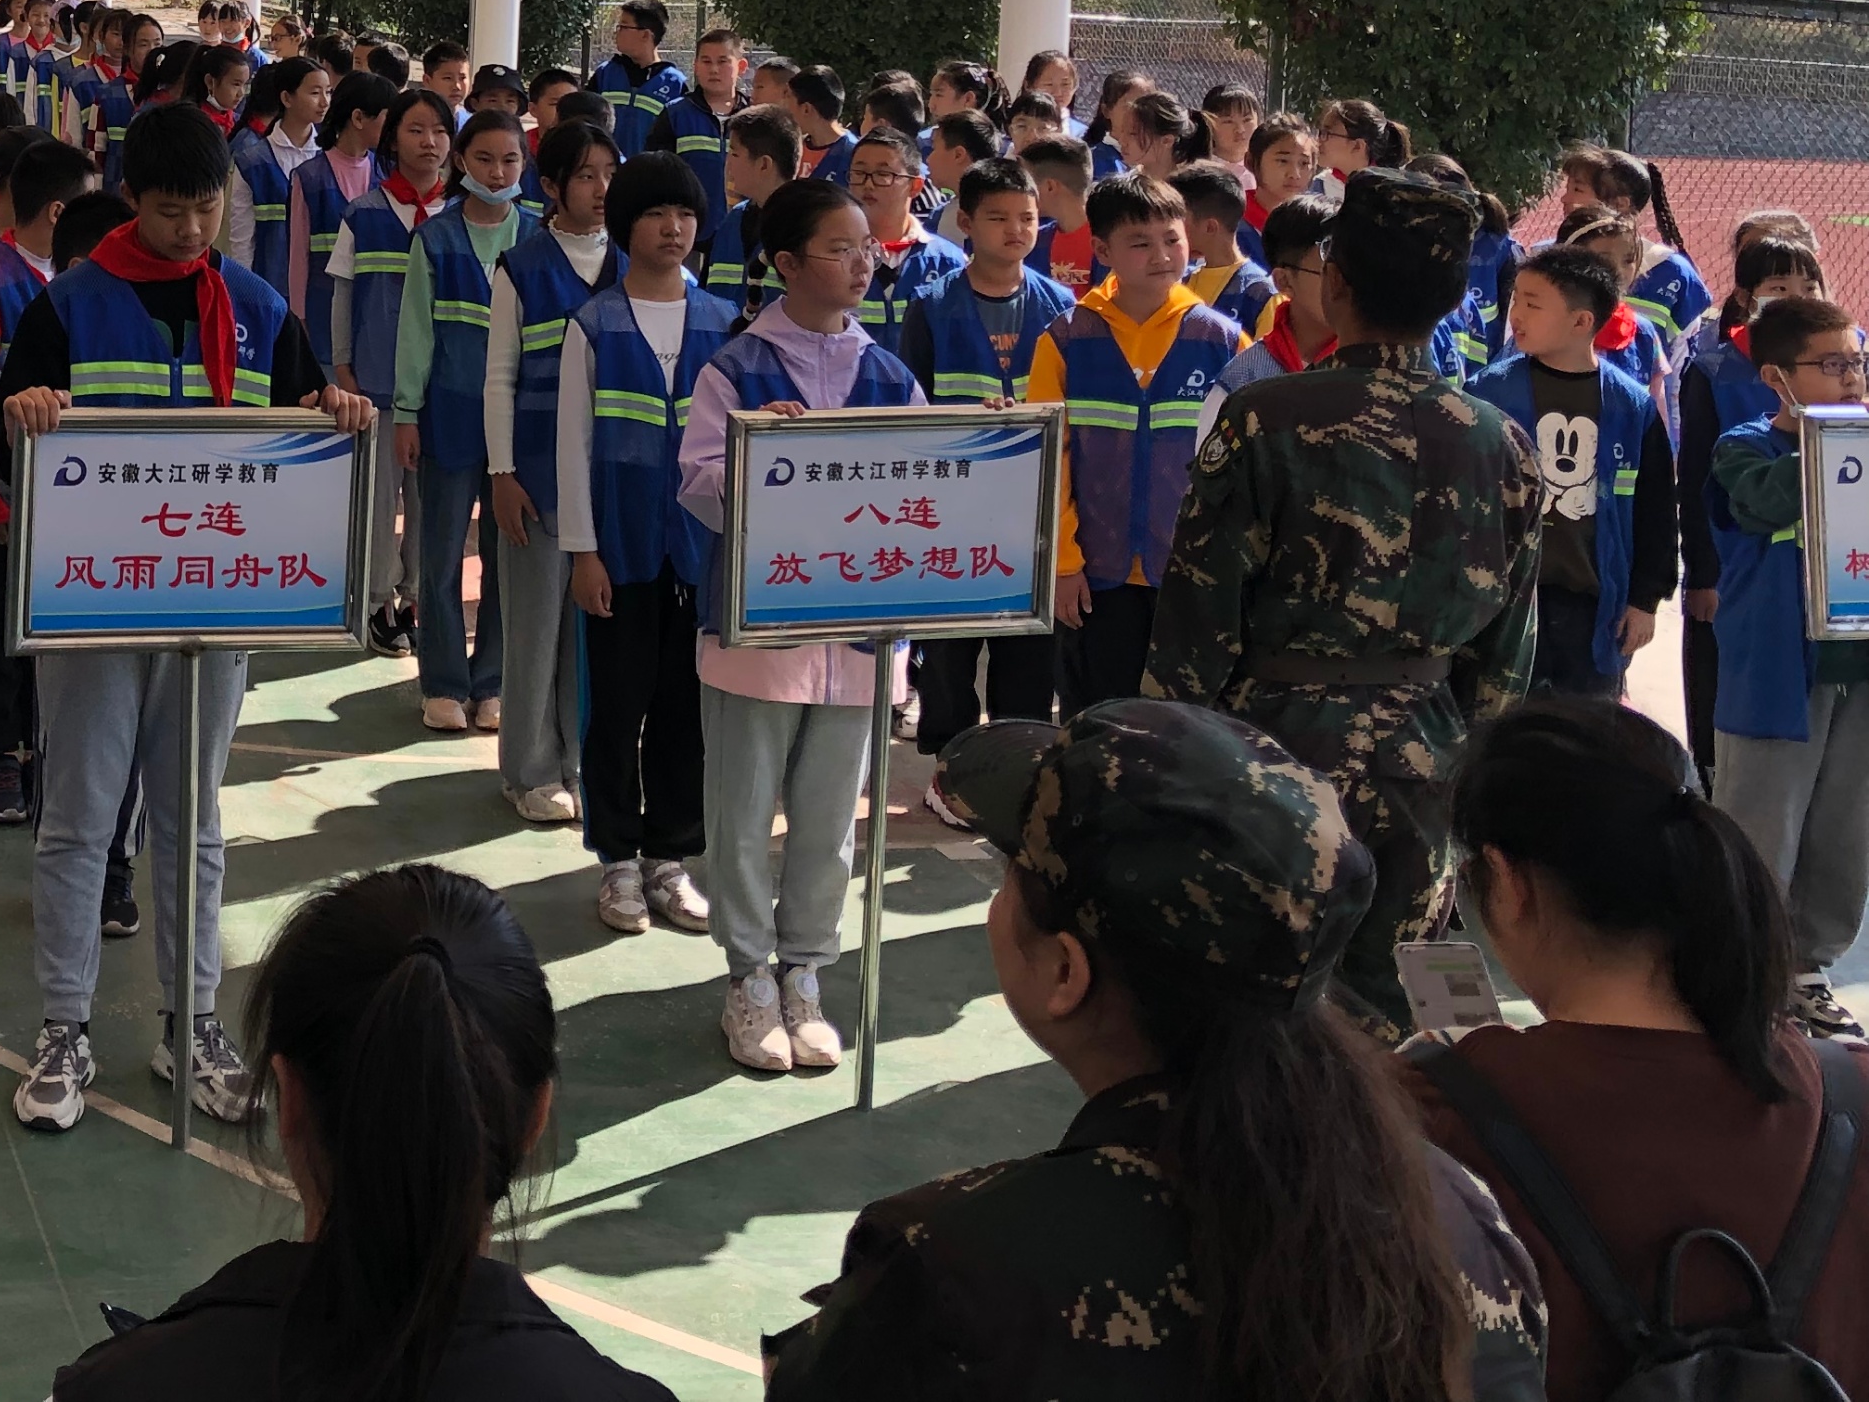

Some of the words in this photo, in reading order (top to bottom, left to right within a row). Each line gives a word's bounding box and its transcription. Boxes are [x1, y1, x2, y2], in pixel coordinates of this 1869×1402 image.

[98, 461, 280, 485] 安徽大江研学教育
[804, 458, 972, 483] 安徽大江研学教育
[141, 502, 247, 538] 七连
[843, 496, 942, 530] 八连
[54, 552, 328, 591] 风雨同舟队
[765, 544, 1015, 586] 放飞梦想队
